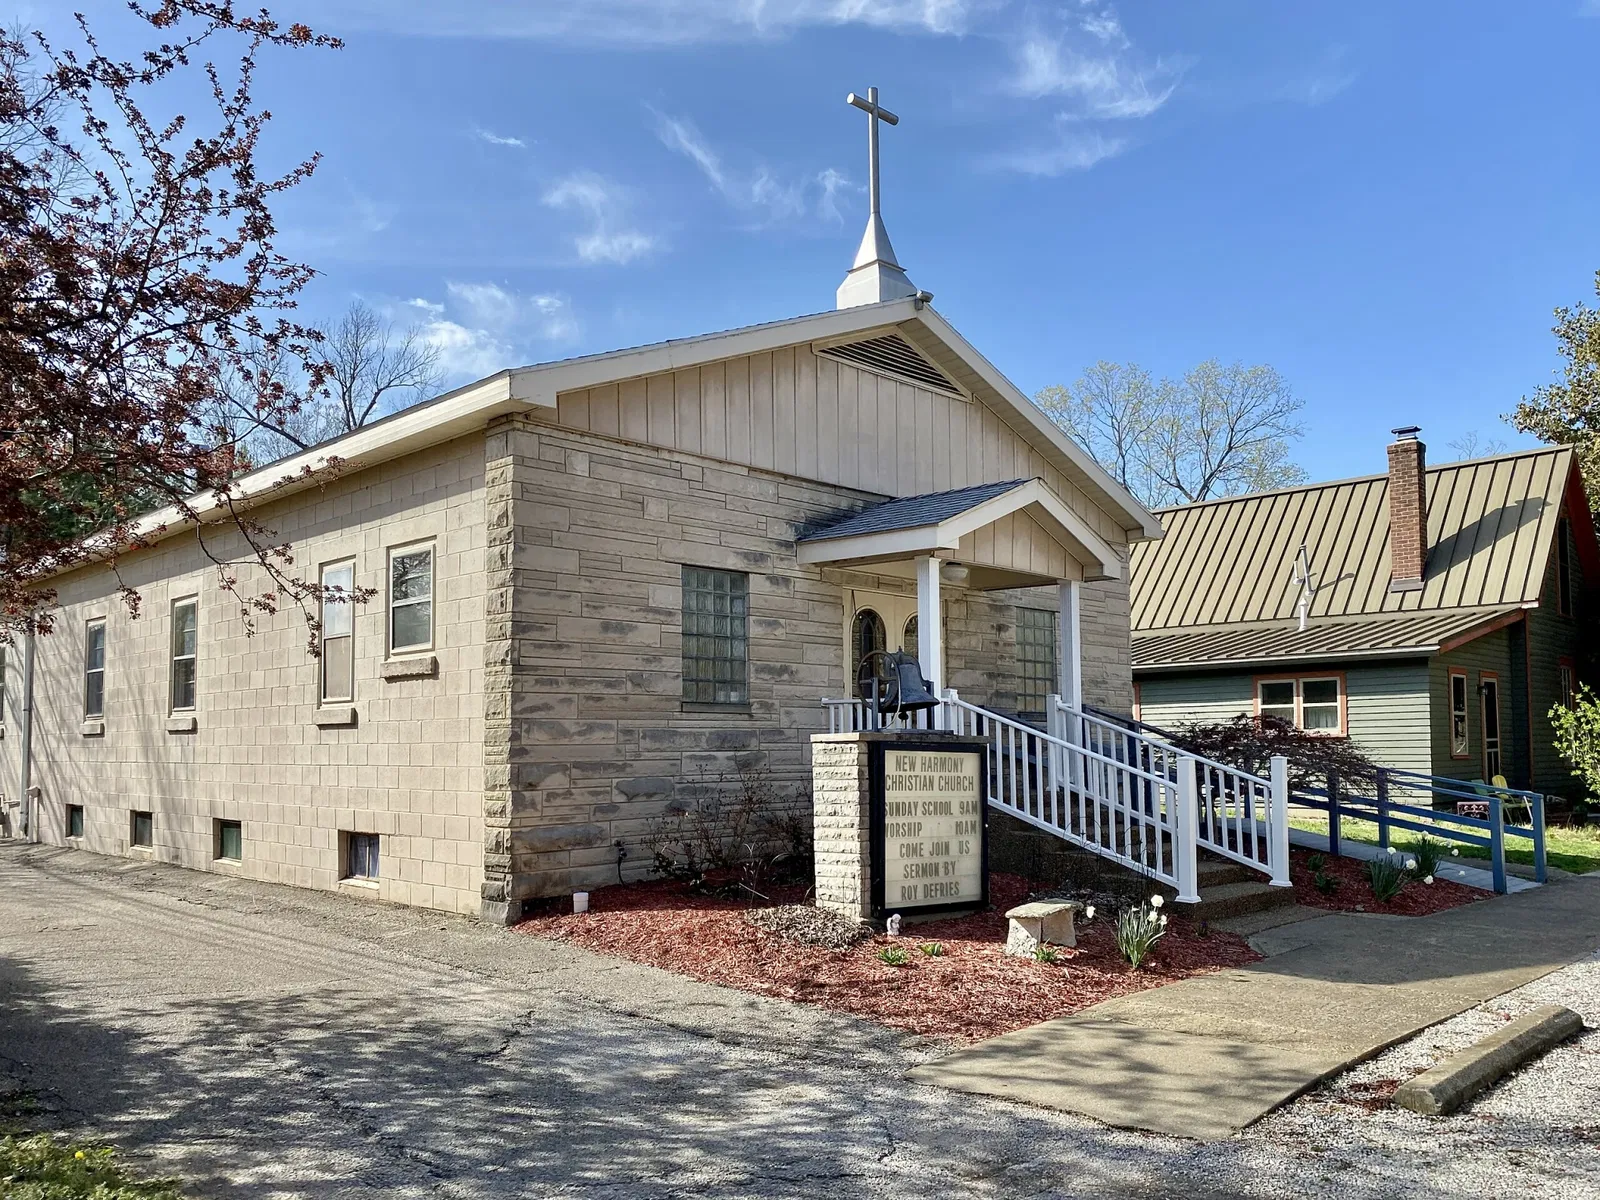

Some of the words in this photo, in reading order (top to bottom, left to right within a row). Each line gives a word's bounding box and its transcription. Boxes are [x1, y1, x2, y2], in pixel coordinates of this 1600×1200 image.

[895, 755, 917, 772] NEW
[920, 756, 964, 773] HARMONY
[885, 774, 934, 791] CHRISTIAN
[938, 775, 974, 791] CHURCH
[921, 801, 953, 816] SCHOOL
[959, 800, 978, 815] 9AM
[955, 820, 977, 835] 10AM
[900, 842, 924, 858] COME
[929, 841, 950, 857] JOIN
[958, 840, 970, 855] US
[903, 862, 939, 879] SERMON
[943, 861, 956, 876] BY
[901, 884, 918, 901] ROY
[923, 881, 960, 899] DEFRIES
